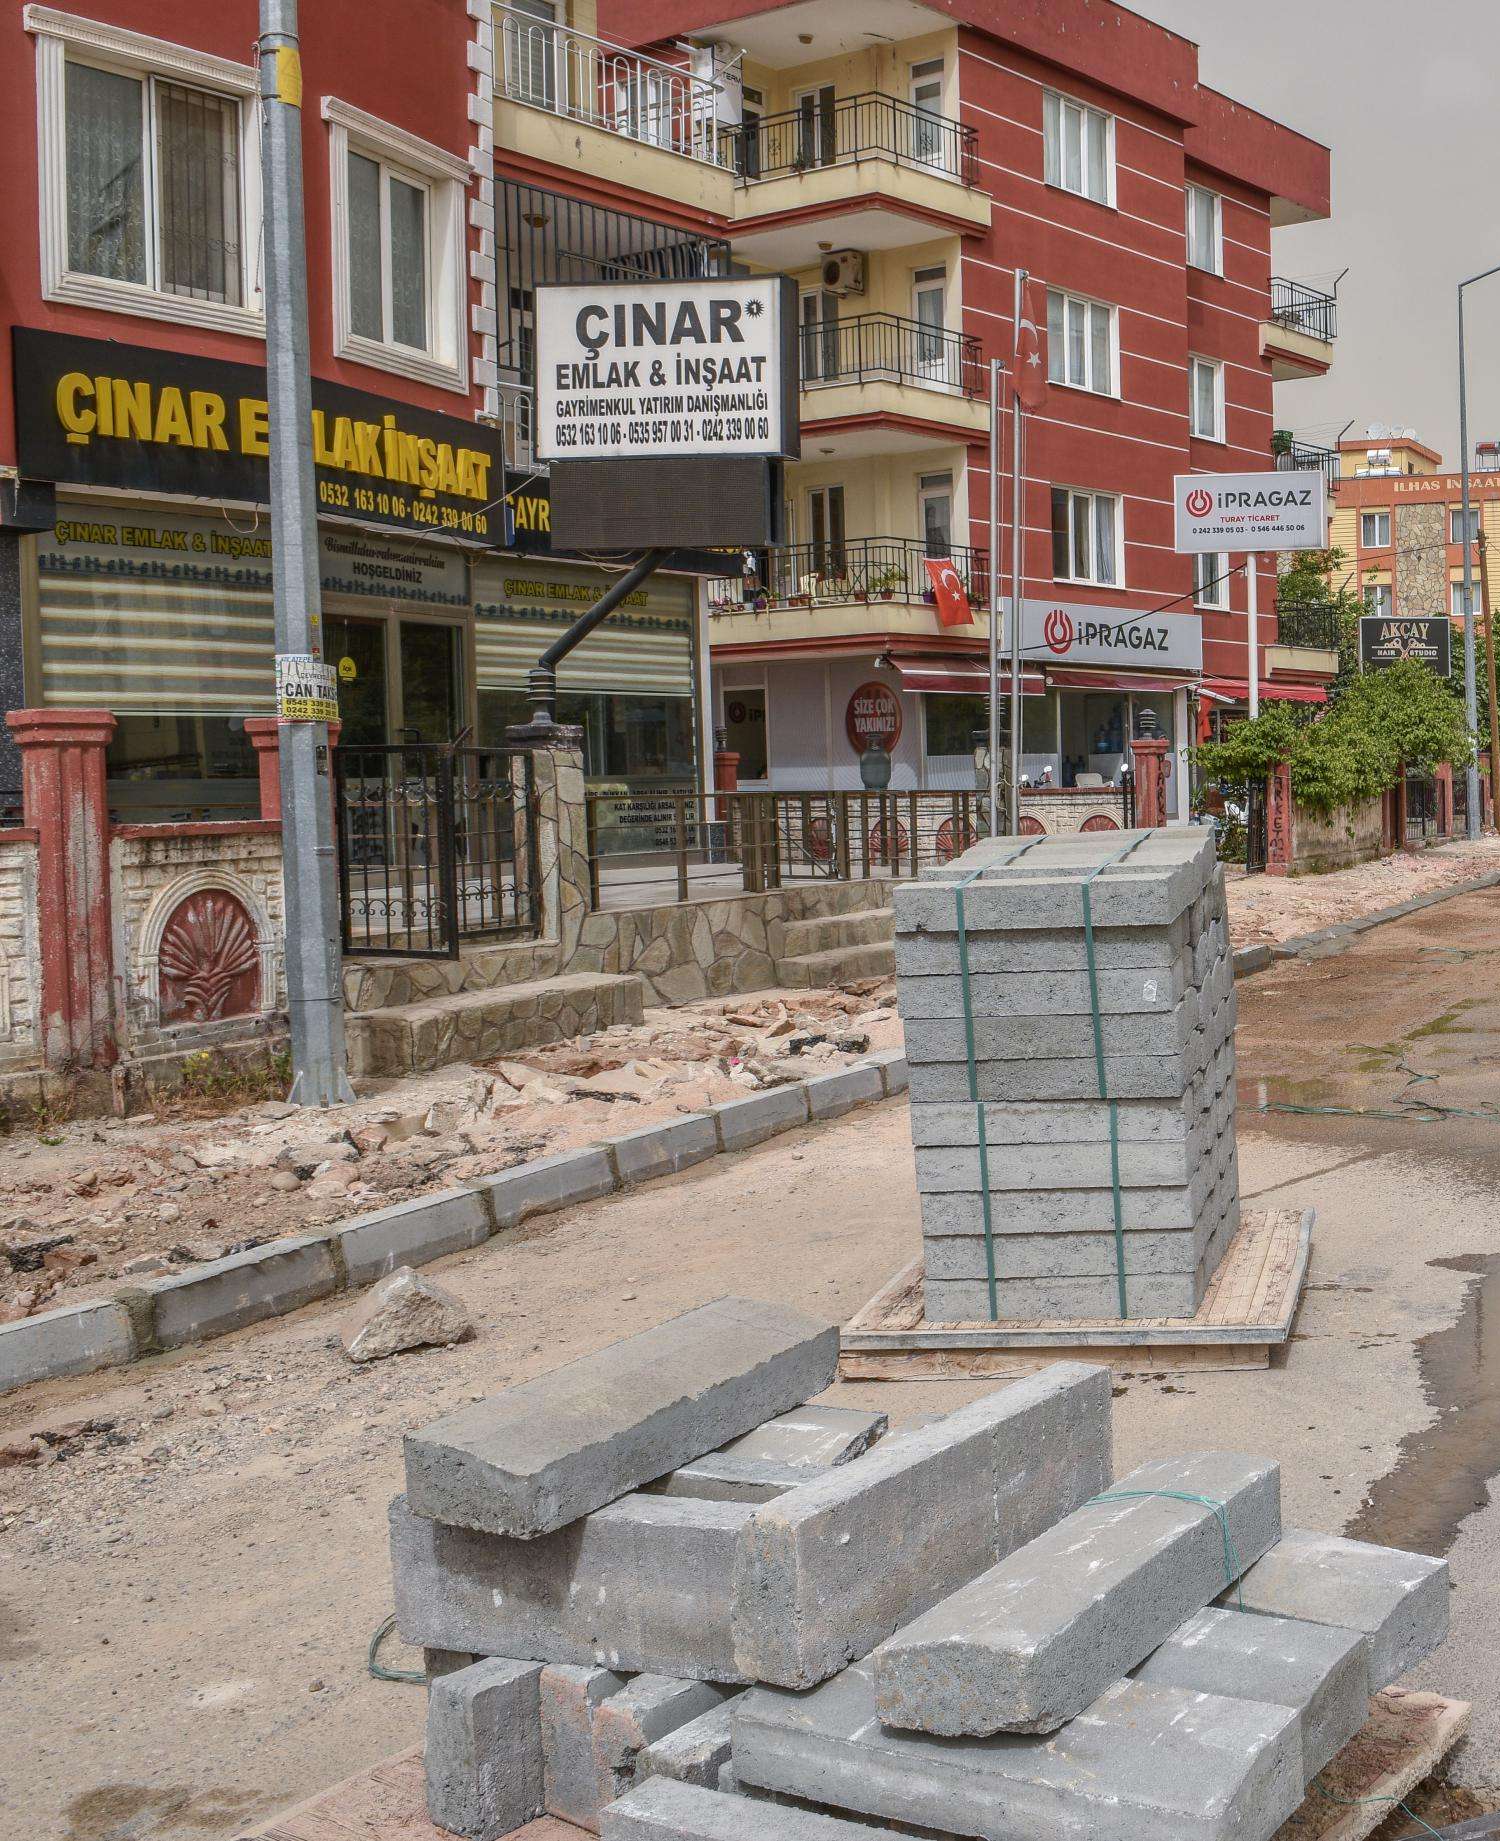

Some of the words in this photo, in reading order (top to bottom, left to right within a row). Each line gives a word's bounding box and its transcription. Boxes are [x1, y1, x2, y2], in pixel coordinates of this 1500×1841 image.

[576, 299, 745, 360] ÇINAR
[556, 361, 641, 390] EMLAK
[649, 359, 667, 386] &
[676, 352, 766, 391] İNŞAAT
[556, 395, 636, 417] GAYRİMENKUL
[639, 397, 684, 415] YATIRIM
[687, 388, 768, 416] DANIŞMANLIĞI
[56, 371, 230, 451] ÇINAR
[239, 397, 384, 477] ELAK
[384, 414, 491, 500] İNŞAAT
[556, 424, 577, 446] 0532
[580, 423, 595, 445] 163
[598, 423, 608, 445] 10
[610, 422, 621, 444] 06
[628, 421, 650, 444] 0535
[652, 420, 668, 443] 957
[670, 420, 681, 442] 00
[683, 419, 694, 442] 31
[702, 418, 723, 441] 0242
[725, 418, 742, 440] 339
[744, 417, 755, 440] 00
[758, 416, 769, 440] 60
[319, 481, 349, 507] 0532
[354, 488, 374, 512] 163
[376, 493, 389, 515] 10
[392, 496, 406, 518] 06
[412, 501, 439, 525] 0242
[441, 506, 458, 529] 339
[461, 511, 473, 532] 00
[475, 514, 487, 535] 60
[1220, 515, 1246, 523] TURAY
[1248, 514, 1280, 522] TİCARET
[54, 520, 118, 546] ÇINAR
[121, 526, 189, 551] EMLAK
[191, 532, 207, 553] &
[210, 530, 273, 560] İNŞAAT
[353, 561, 423, 584] HOŞGELDİNİZ
[504, 578, 545, 599] ÇINAR
[546, 582, 591, 602] EMLAK
[1380, 622, 1429, 640] AKÇAY
[285, 682, 313, 697] CAN
[286, 706, 308, 714] 0242
[854, 696, 874, 715] SİZE
[876, 699, 895, 717] ÇOK
[854, 717, 896, 733] YAKINIZ!
